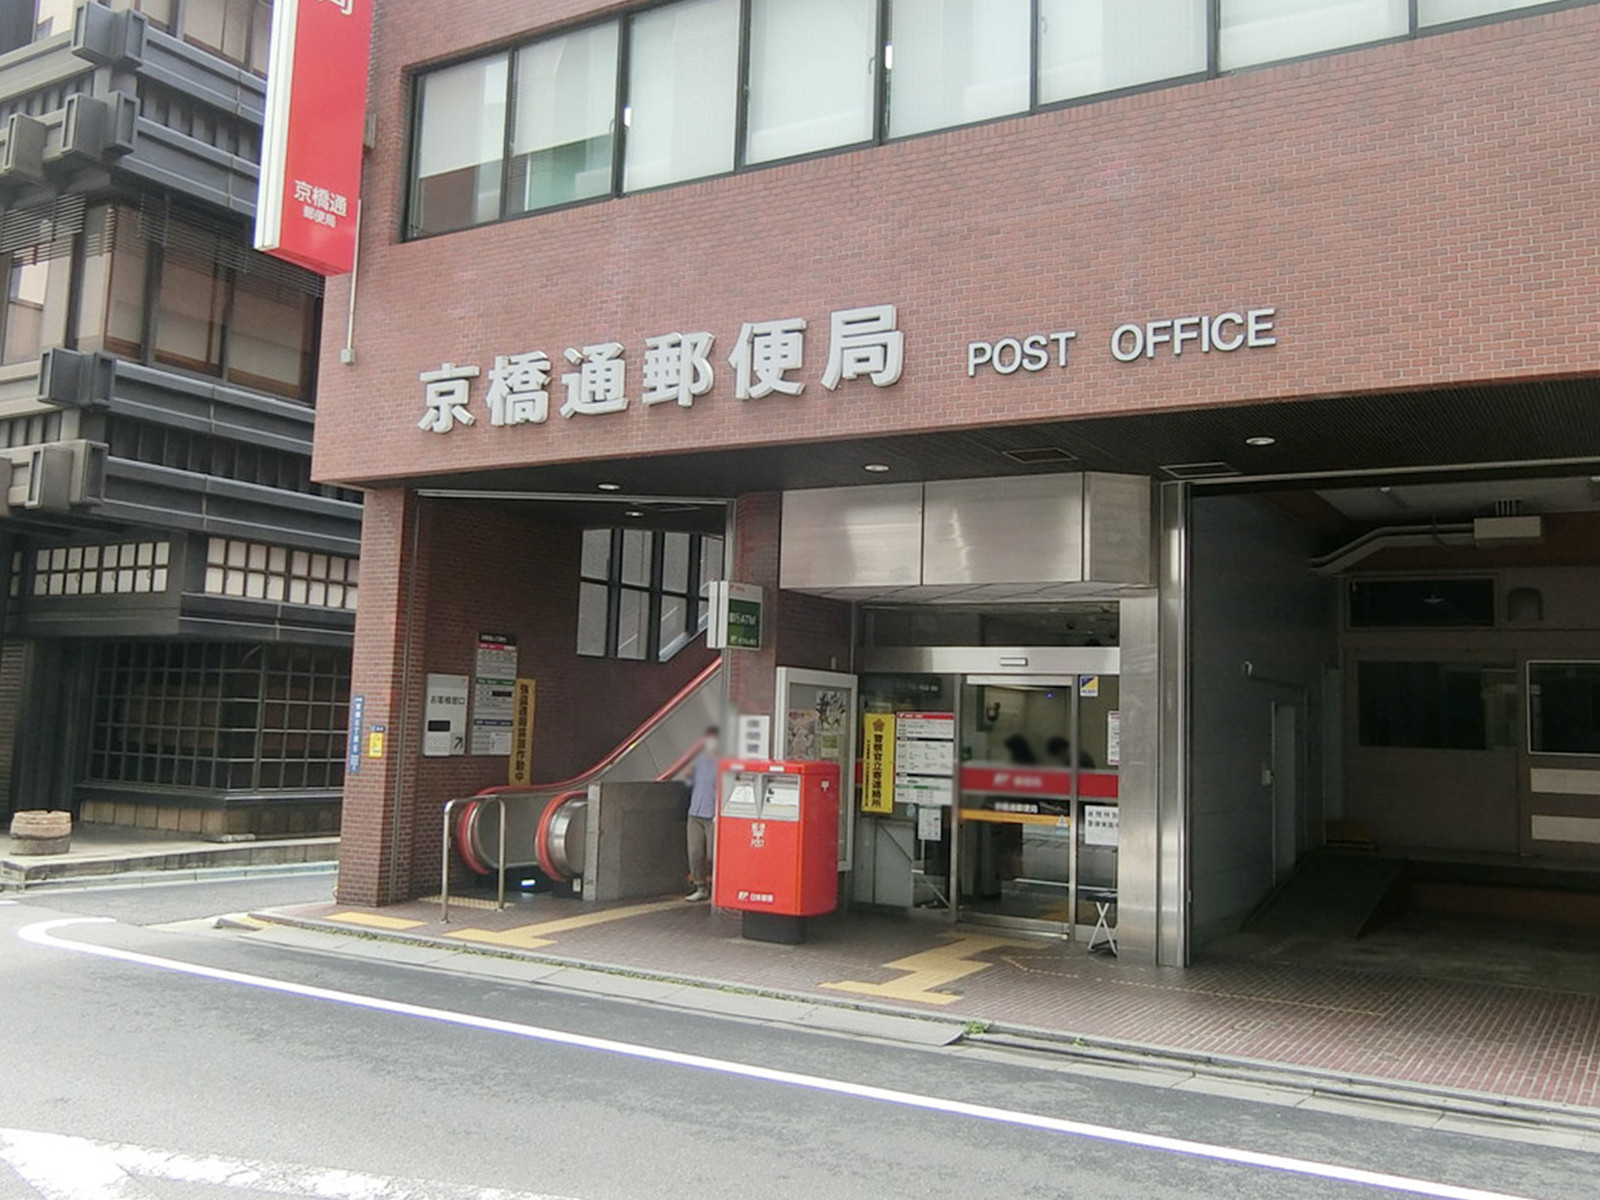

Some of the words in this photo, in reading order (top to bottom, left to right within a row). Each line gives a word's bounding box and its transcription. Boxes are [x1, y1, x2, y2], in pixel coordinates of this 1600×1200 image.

[293, 180, 347, 217] 京橋通
[303, 205, 337, 228] 郵便局
[417, 304, 905, 434] 京橋通郵便局
[967, 331, 1077, 377] POST
[1111, 308, 1277, 362] OFFICE
